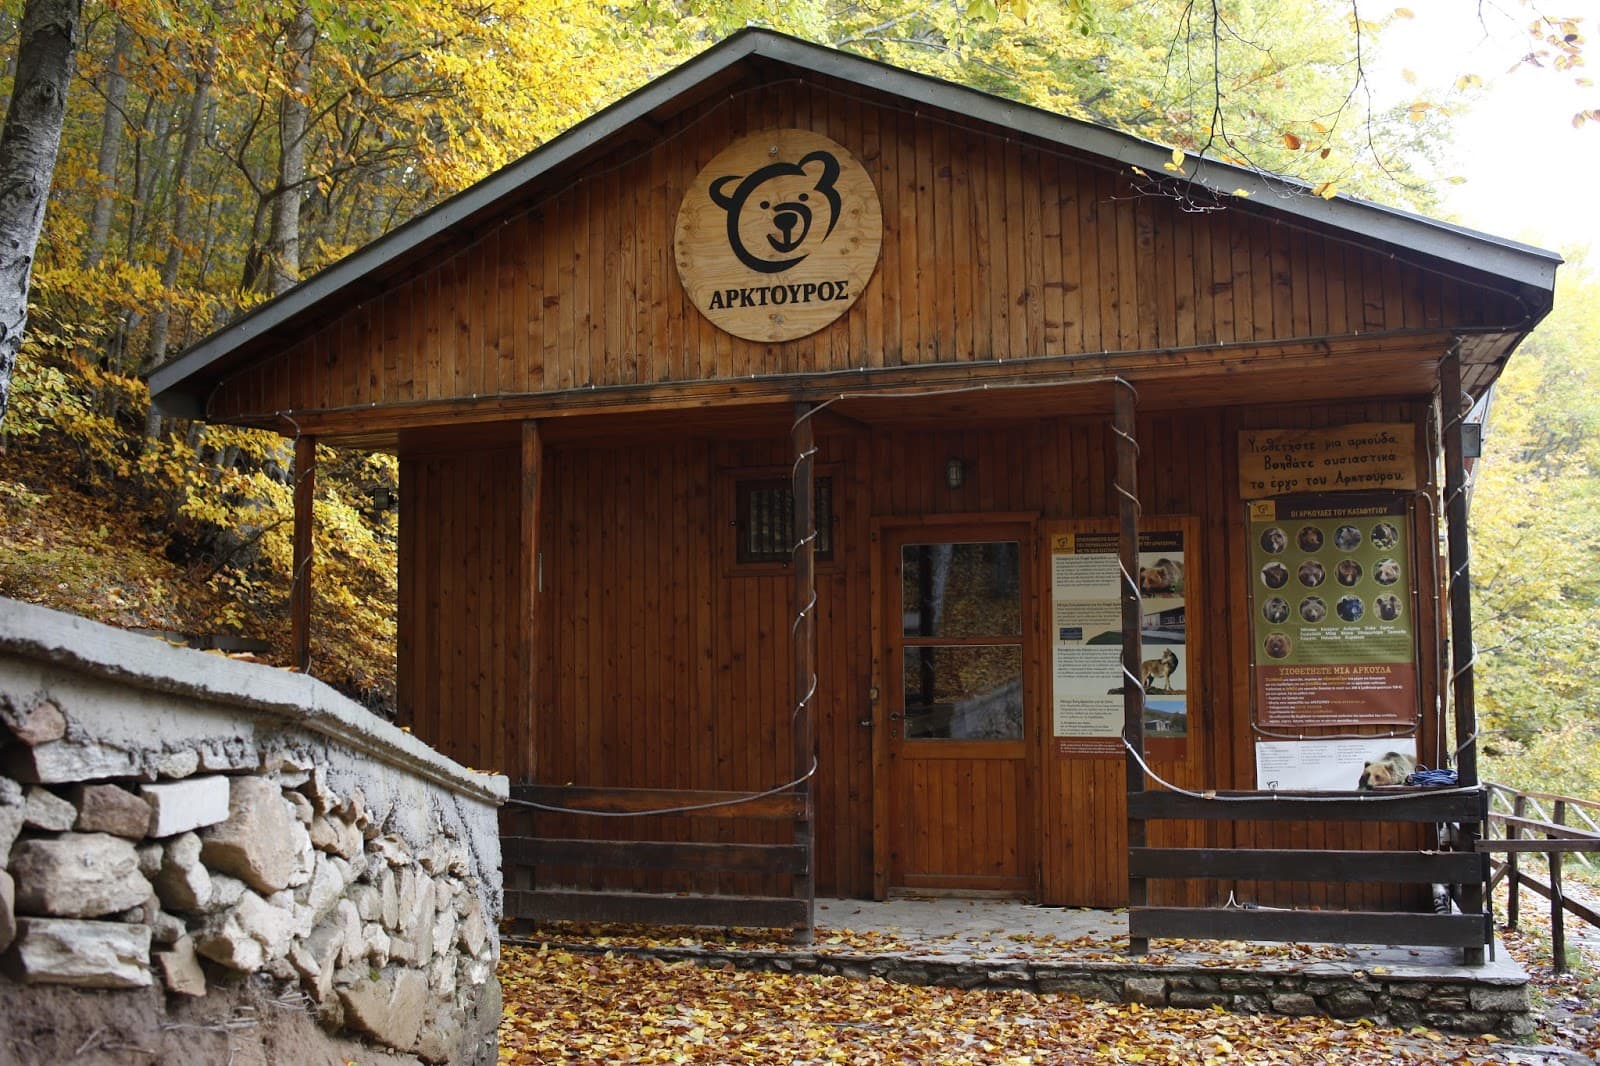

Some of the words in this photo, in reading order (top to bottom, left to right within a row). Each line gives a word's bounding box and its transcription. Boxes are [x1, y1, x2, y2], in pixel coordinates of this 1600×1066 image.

[709, 280, 849, 310] ΑΡΚΤΟΥΡΟΣ
[1325, 439, 1341, 450] μια
[1264, 455, 1314, 470] Βοηθάτε
[1324, 452, 1397, 466] ουσιαστικά
[1250, 480, 1265, 489] το
[1270, 477, 1298, 492] έργο
[1306, 476, 1327, 486] του
[1352, 666, 1392, 674] ΑΡΚΟΥΔΑ
